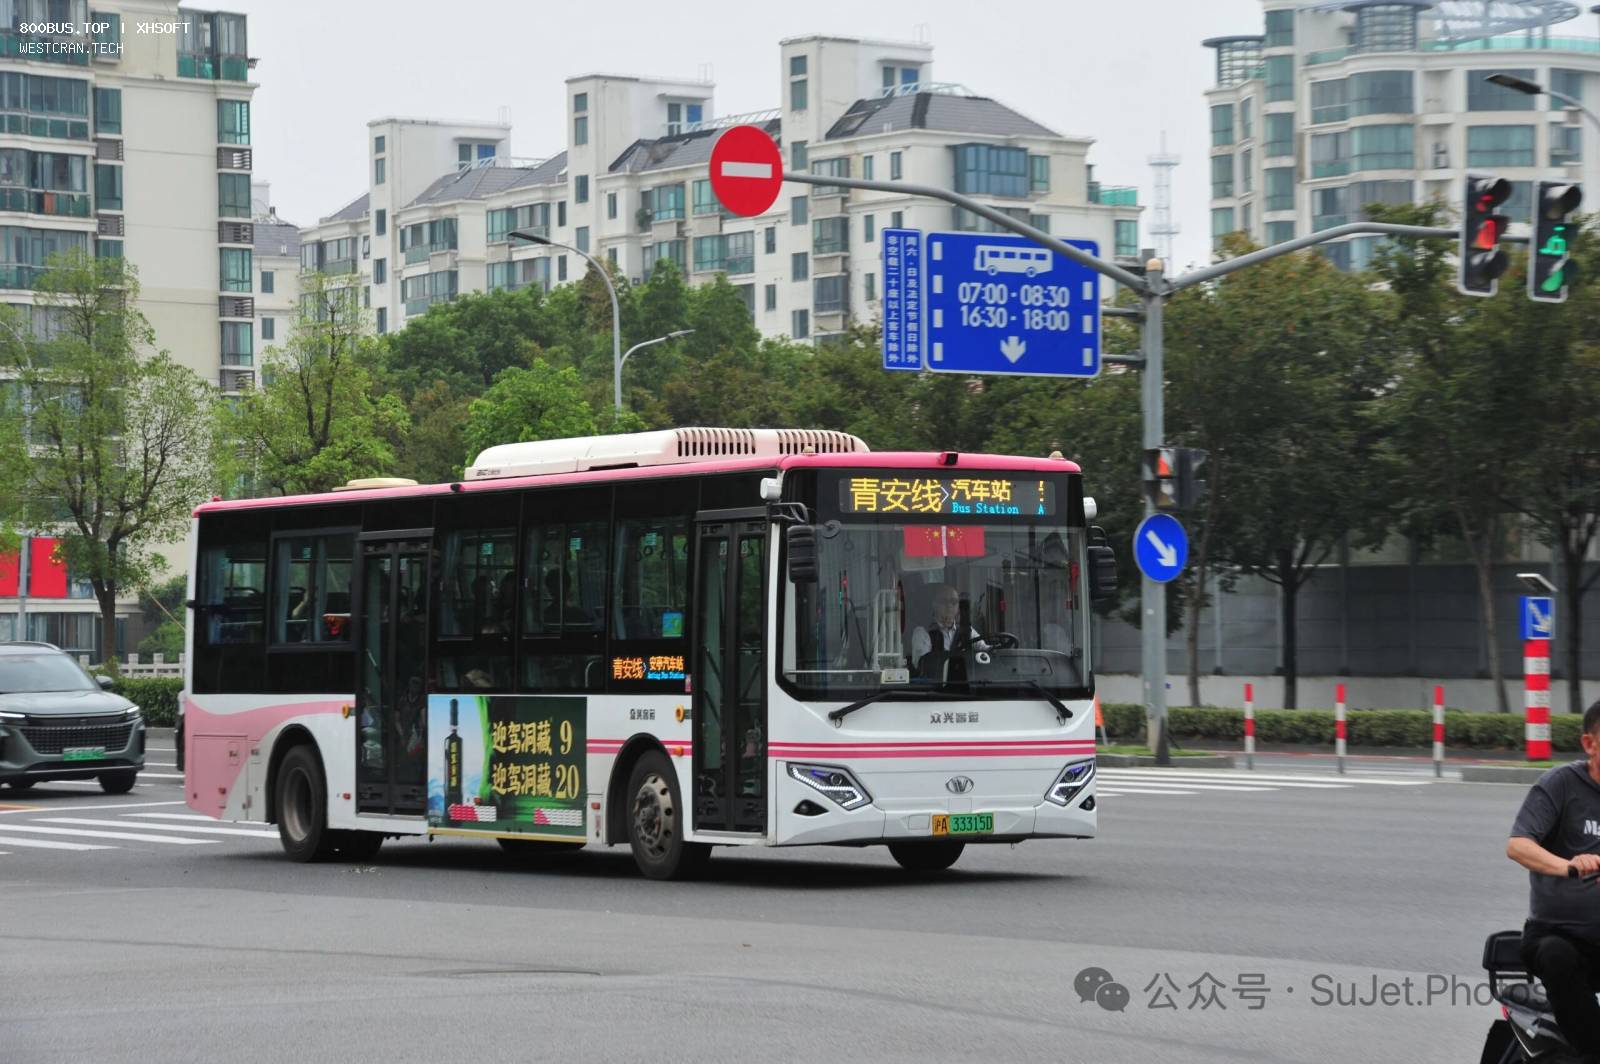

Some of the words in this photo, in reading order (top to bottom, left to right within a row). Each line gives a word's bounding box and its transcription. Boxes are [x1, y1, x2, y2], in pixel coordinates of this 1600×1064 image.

[850, 478, 942, 512] 青安线
[951, 479, 1012, 502] 汽车站
[951, 502, 971, 514] Bus
[976, 503, 1019, 515] Station
[613, 657, 643, 679] 青安线
[649, 656, 684, 671] 安亭汽车站
[492, 721, 552, 755] 迎驾洞藏
[559, 719, 573, 755] 9
[492, 763, 552, 797] 迎驾洞藏
[555, 764, 580, 800] 20
